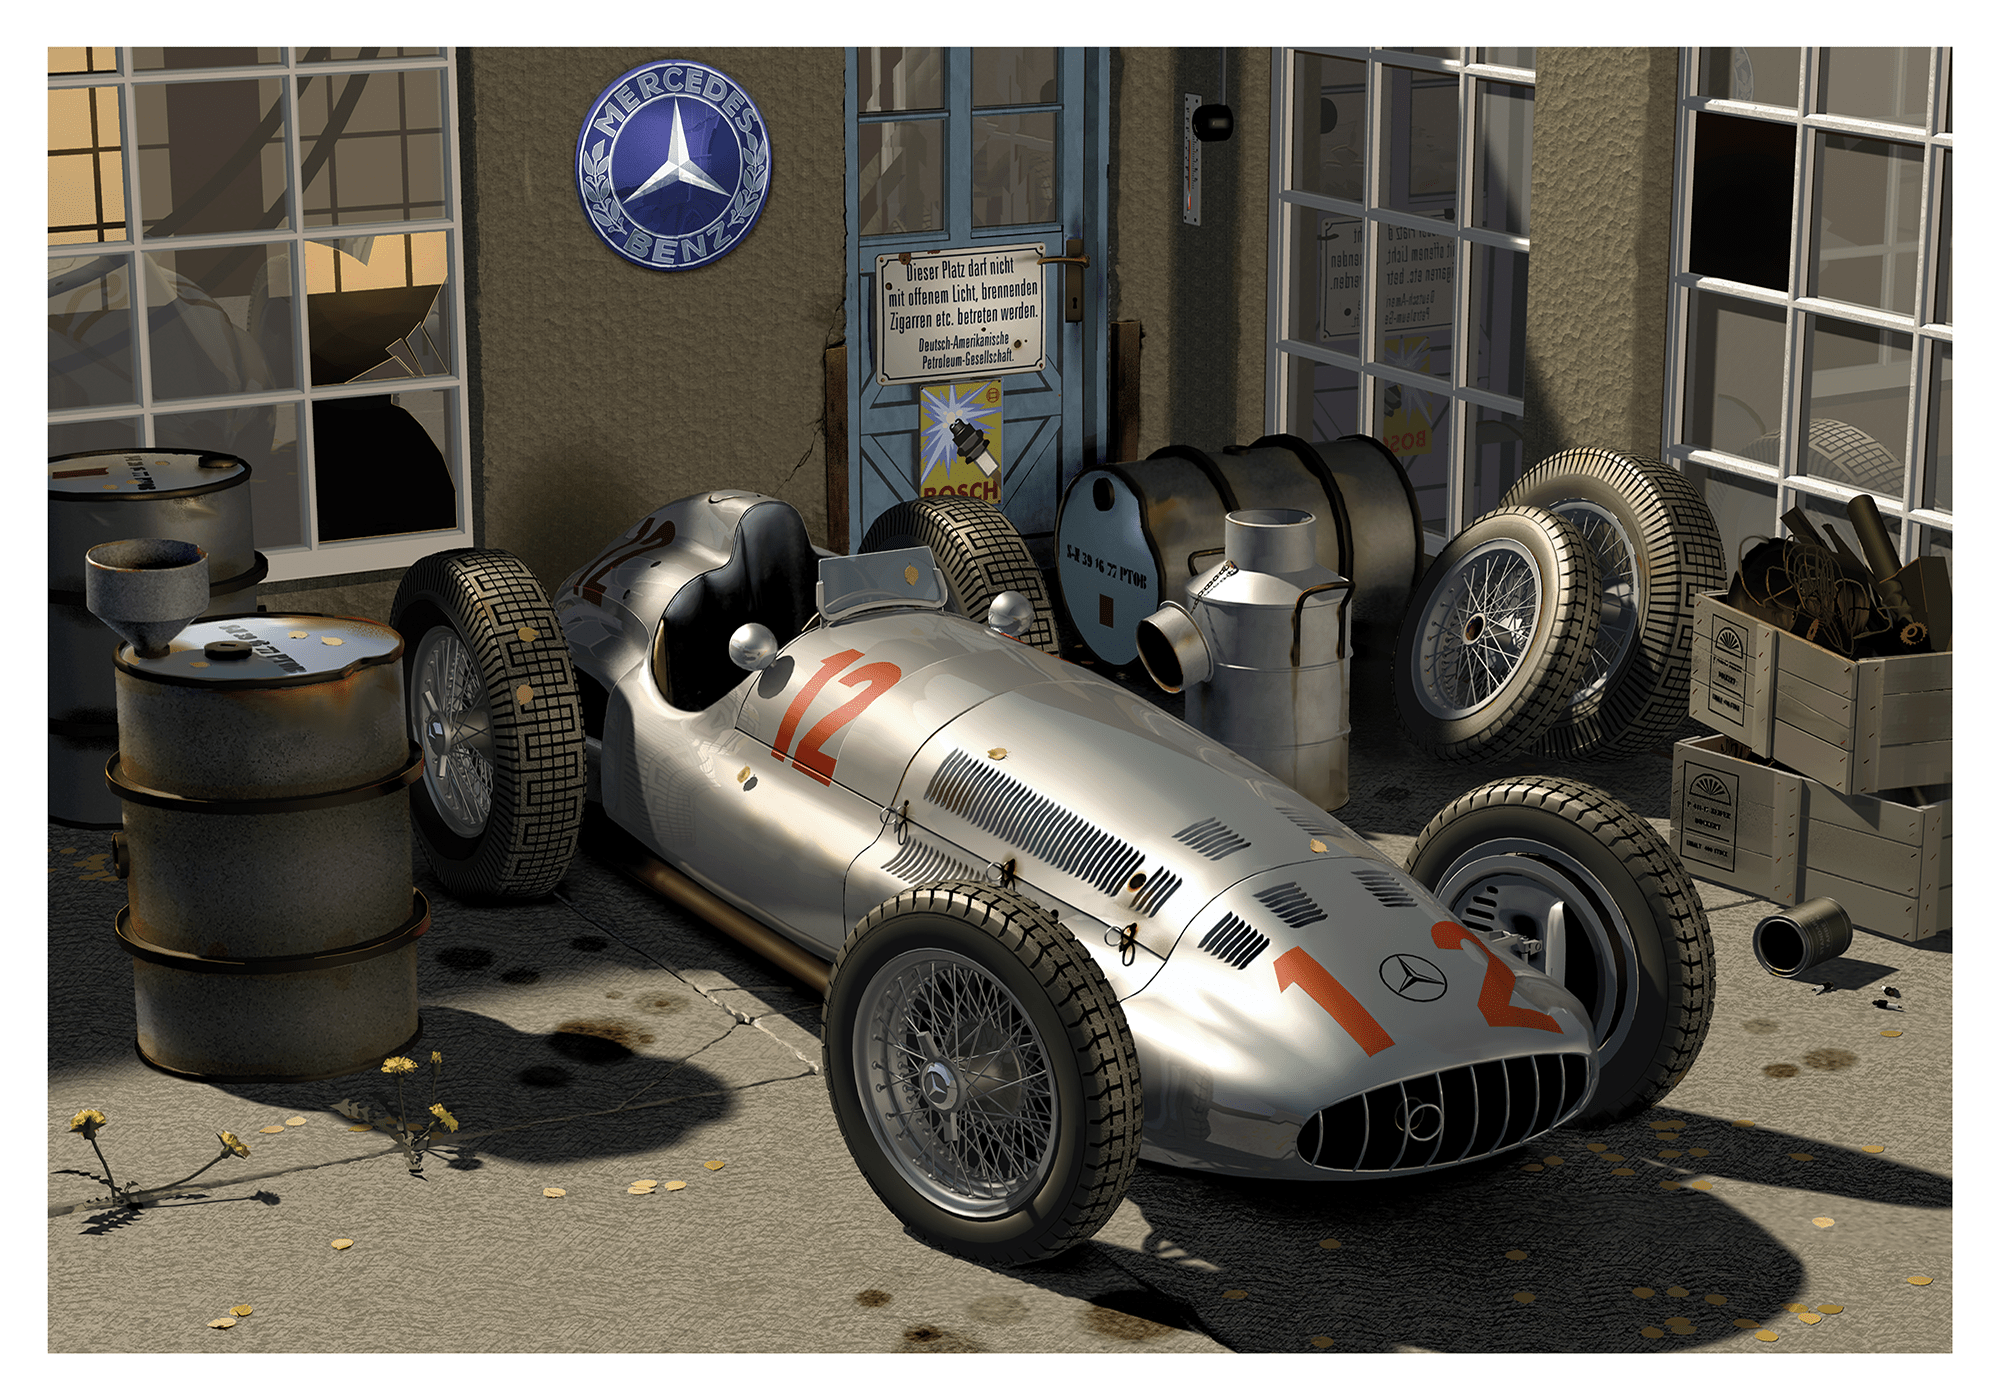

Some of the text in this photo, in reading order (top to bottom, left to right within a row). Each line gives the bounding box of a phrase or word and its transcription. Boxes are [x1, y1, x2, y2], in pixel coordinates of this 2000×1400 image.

[593, 66, 759, 138] MERCEDES
[623, 220, 732, 264] BENZ
[906, 256, 1014, 282] Dieser Platz darf nicht
[888, 278, 1038, 308] mit offenem Licht, brennenden
[890, 302, 1038, 334] Zigarren etc. betreten werden.
[918, 331, 1009, 353] Deutsch-Amerikanische
[922, 349, 1014, 370] Petroleum-Gesellschaft.
[573, 517, 676, 607] 12
[771, 648, 902, 787] 12
